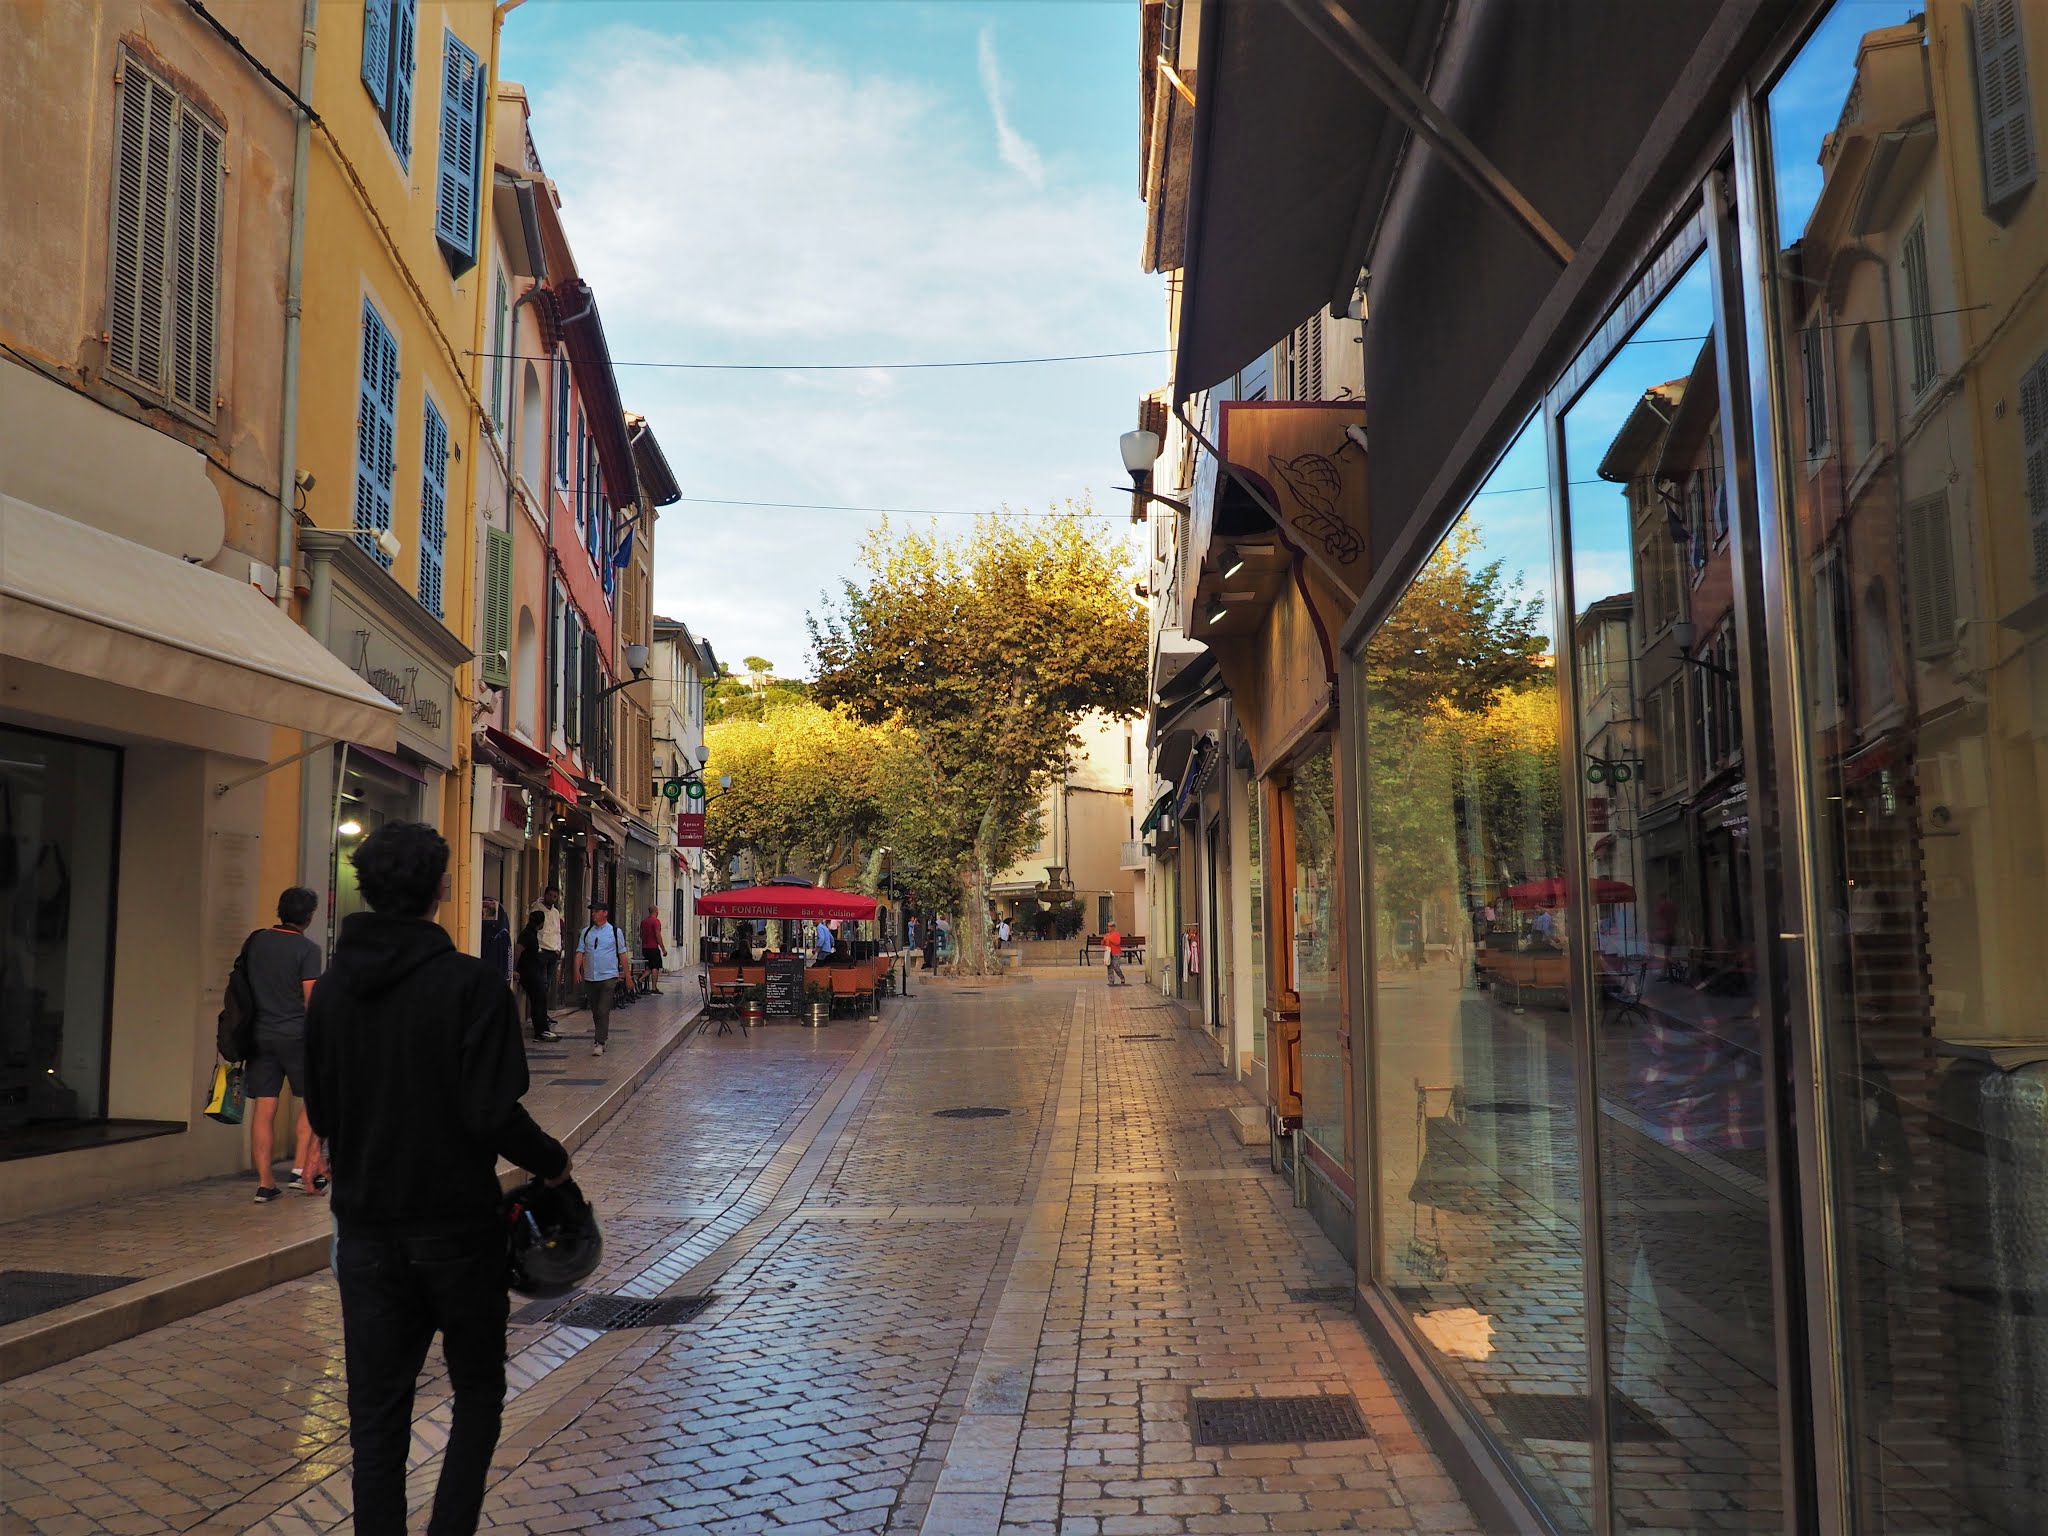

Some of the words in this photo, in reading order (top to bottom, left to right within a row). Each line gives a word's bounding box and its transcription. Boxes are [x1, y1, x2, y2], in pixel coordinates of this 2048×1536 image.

[714, 905, 727, 914] LA
[732, 906, 778, 915] FONTAINE
[801, 908, 814, 916] Bar
[828, 909, 856, 918] Cuisine
